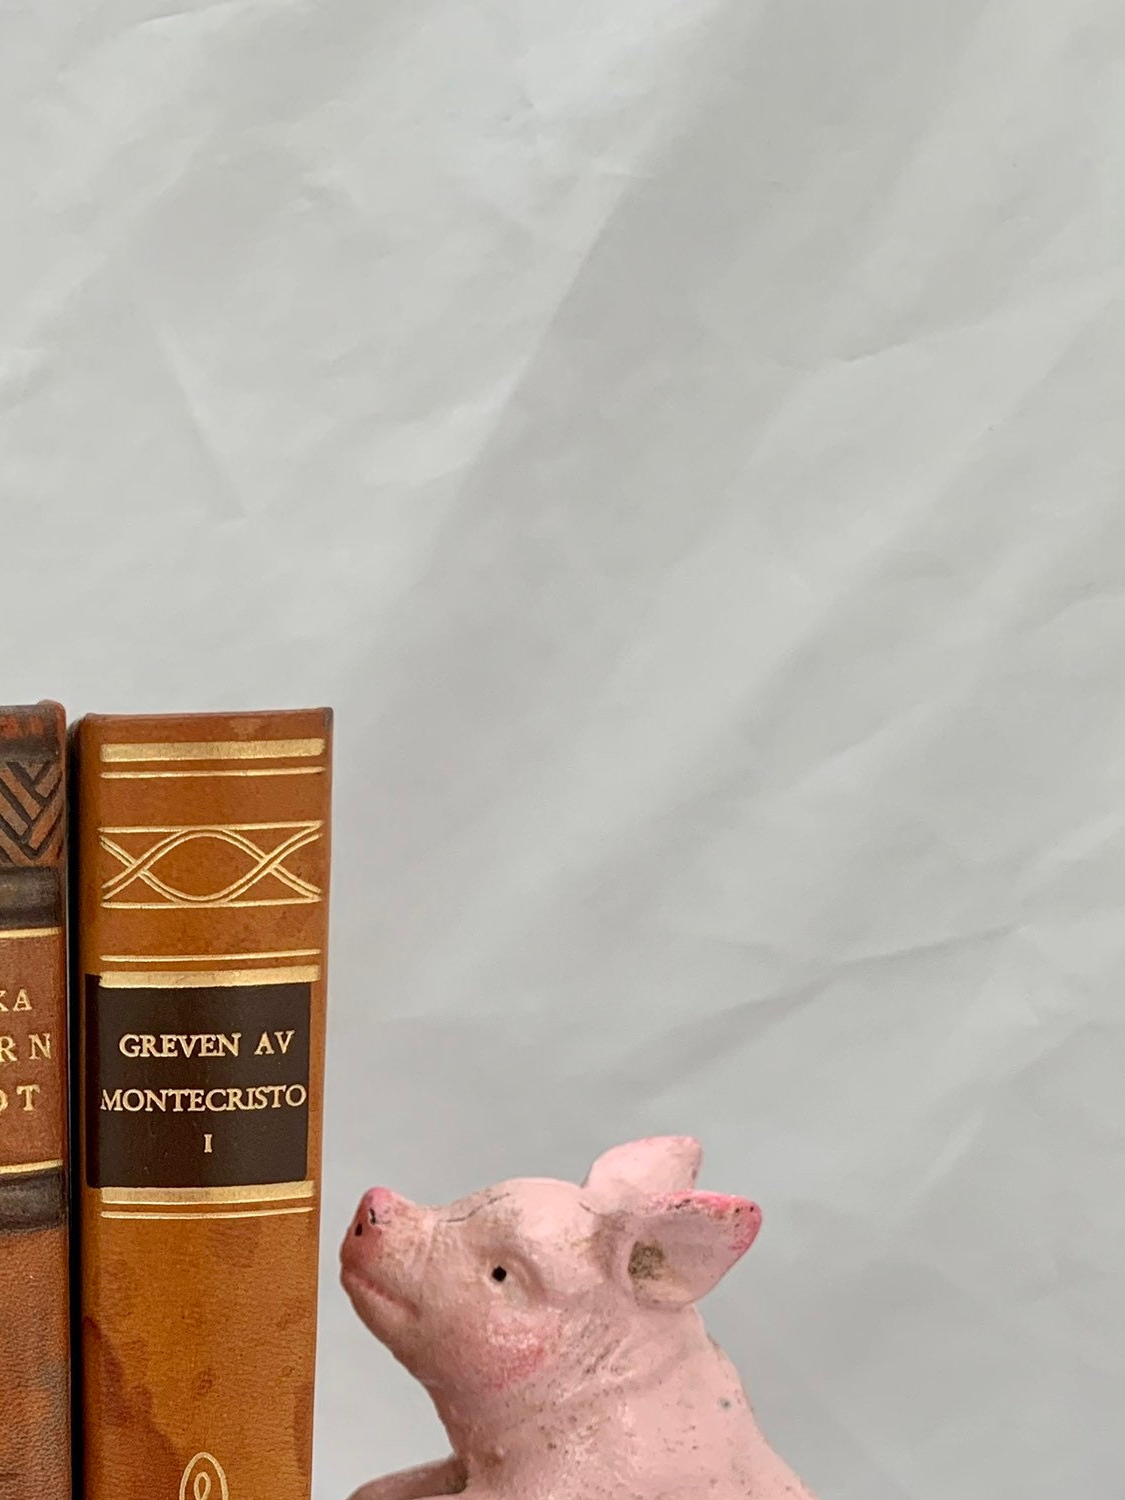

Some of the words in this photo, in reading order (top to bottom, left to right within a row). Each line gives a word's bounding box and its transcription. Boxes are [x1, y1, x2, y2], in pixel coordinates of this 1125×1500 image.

[118, 1032, 242, 1058] GREVEN
[254, 1030, 295, 1055] AV
[100, 1084, 307, 1112] MONTECRISTO
[203, 1133, 213, 1154] I
